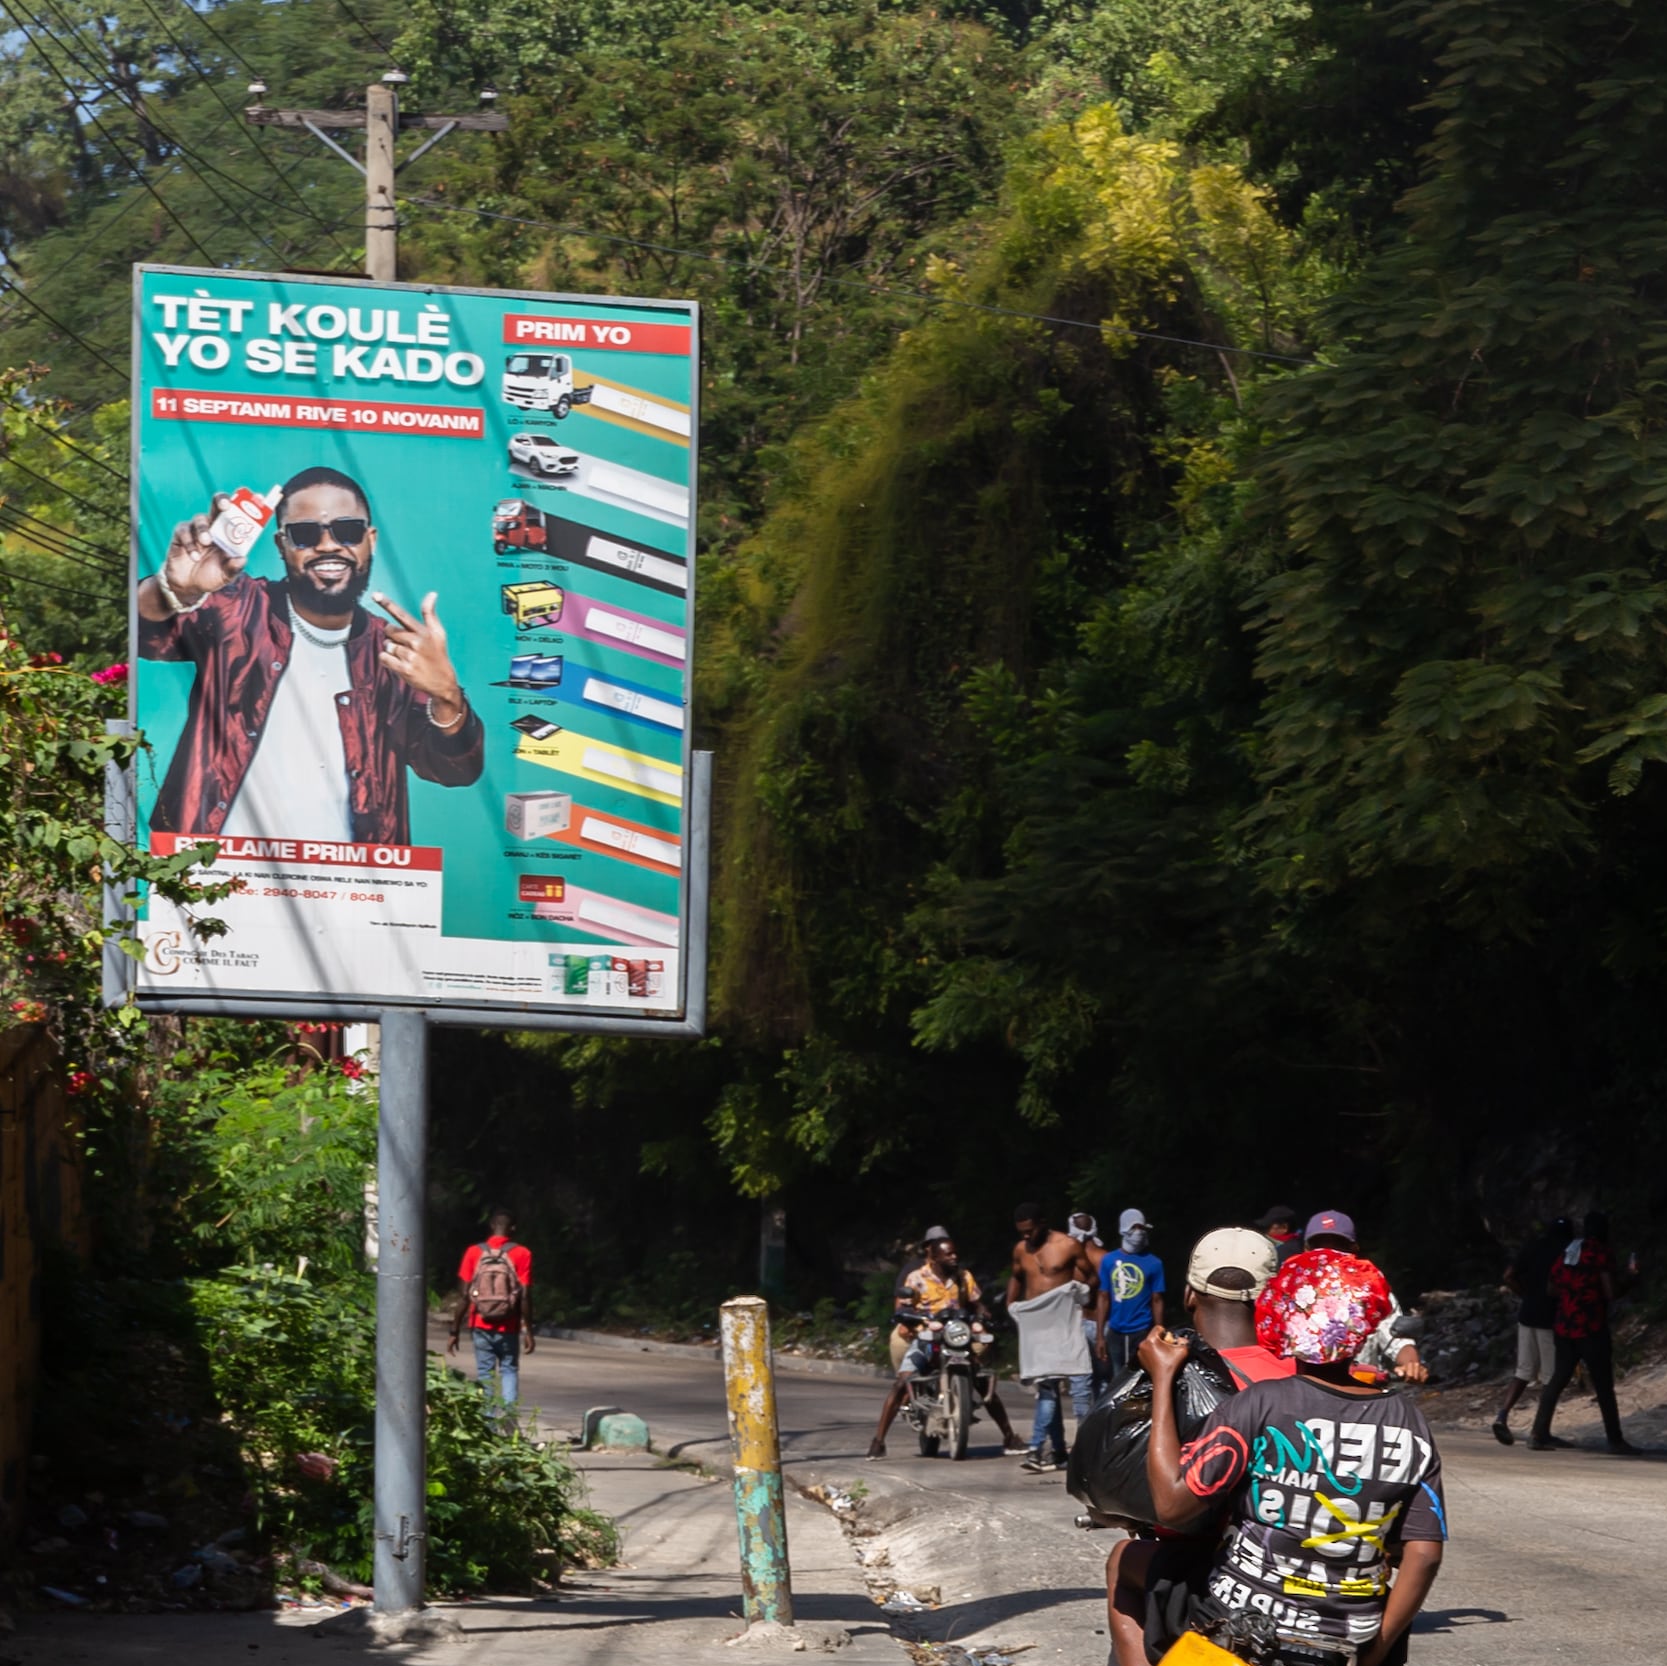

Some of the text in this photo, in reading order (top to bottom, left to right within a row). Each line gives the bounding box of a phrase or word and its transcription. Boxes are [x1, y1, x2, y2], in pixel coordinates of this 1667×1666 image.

[153, 290, 450, 346] TÈT KOULÈ
[516, 320, 631, 345] PRIM YO
[152, 333, 485, 386] YO SE KADO
[157, 398, 479, 431] 11 SEPTANM RIVE 10 NOVANM
[303, 843, 367, 863] PRIM
[373, 847, 411, 866] OU
[264, 887, 336, 899] 2940-8047
[350, 892, 385, 902] 8048
